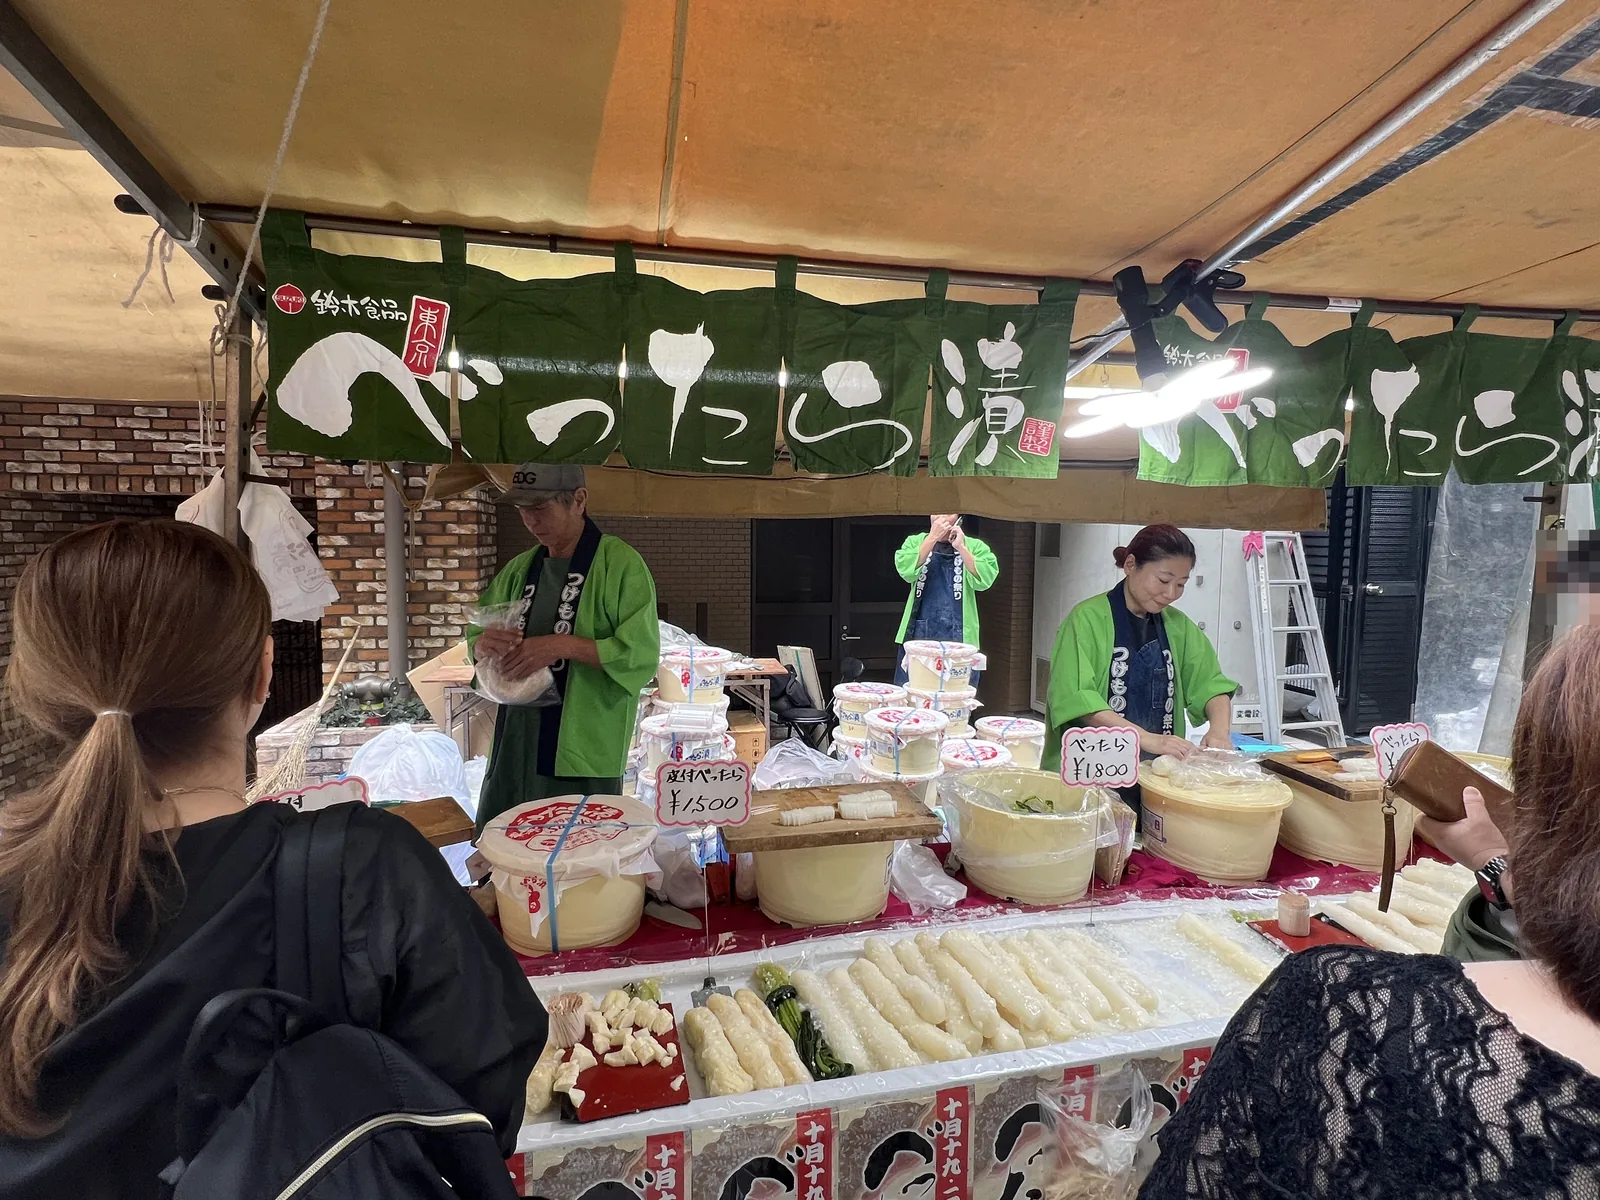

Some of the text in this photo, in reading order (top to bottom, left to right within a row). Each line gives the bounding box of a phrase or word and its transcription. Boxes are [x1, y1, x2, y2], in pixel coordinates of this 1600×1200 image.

[310, 289, 408, 321] 鈴木食品
[409, 304, 440, 369] 東京
[276, 320, 1036, 469] べったら漬
[916, 551, 933, 598] もの祭り
[953, 551, 963, 601] けもの祭り
[1108, 646, 1130, 718] つけもの
[1236, 709, 1262, 719] 変電設
[1070, 737, 1130, 752] べったら
[1380, 731, 1420, 749] べったら
[666, 767, 746, 783] 皮付べったら
[668, 789, 739, 816] ¥1,500
